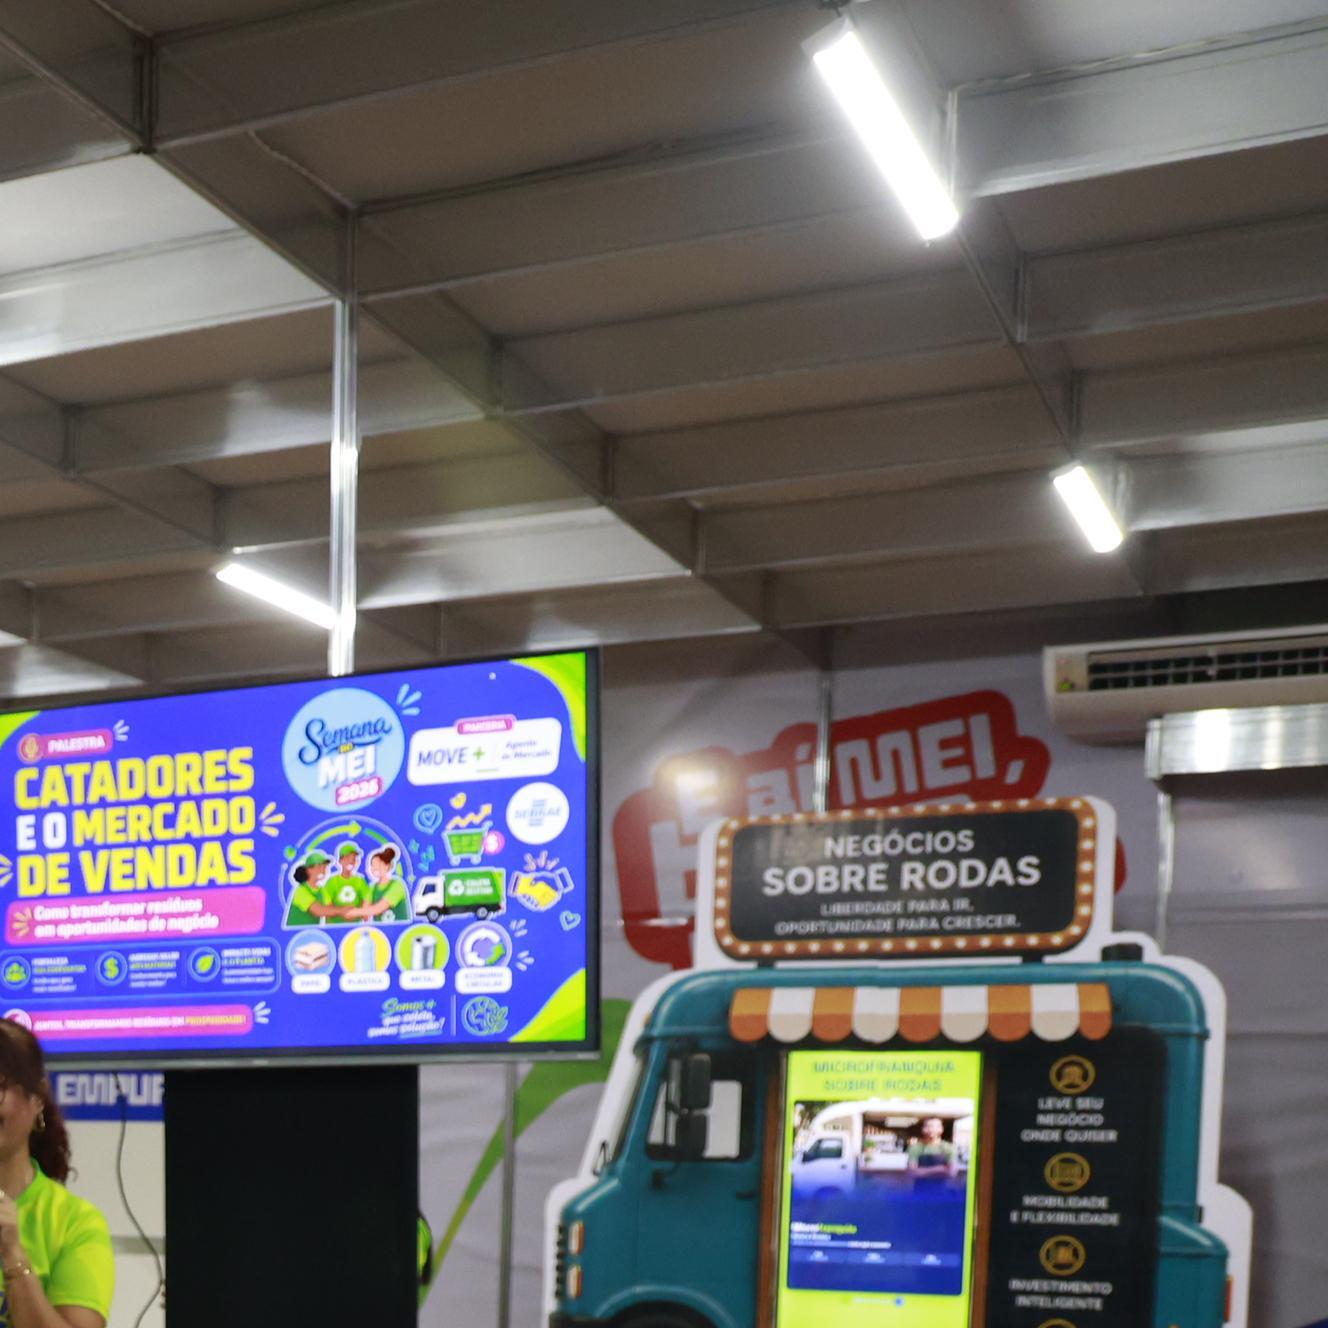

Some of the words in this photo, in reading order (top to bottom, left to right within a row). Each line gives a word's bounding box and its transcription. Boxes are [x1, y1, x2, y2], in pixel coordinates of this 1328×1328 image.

[48, 735, 106, 753] PALESTRA
[299, 717, 392, 765] Semana
[318, 744, 378, 789] MEI
[417, 746, 469, 767] MOVE
[14, 747, 255, 810] CATADORES
[16, 814, 37, 851] E
[42, 811, 67, 849] O
[73, 796, 256, 847] MERCADO
[824, 829, 975, 859] NEGÓCIOS
[17, 853, 71, 897] DE
[79, 839, 256, 894] VENDAS
[762, 862, 888, 896] SOBRE
[900, 856, 1041, 892] RODAS
[34, 904, 69, 921] Como
[70, 900, 146, 919] transformar
[820, 902, 904, 917] LIBERDADE
[908, 900, 949, 914] PARA
[57, 917, 147, 939] oportunidades
[167, 913, 219, 933] negócio
[774, 918, 893, 936] OPORTUNIDADE
[897, 916, 942, 932] PARA
[1022, 1195, 1109, 1209] MOBILIDADE
